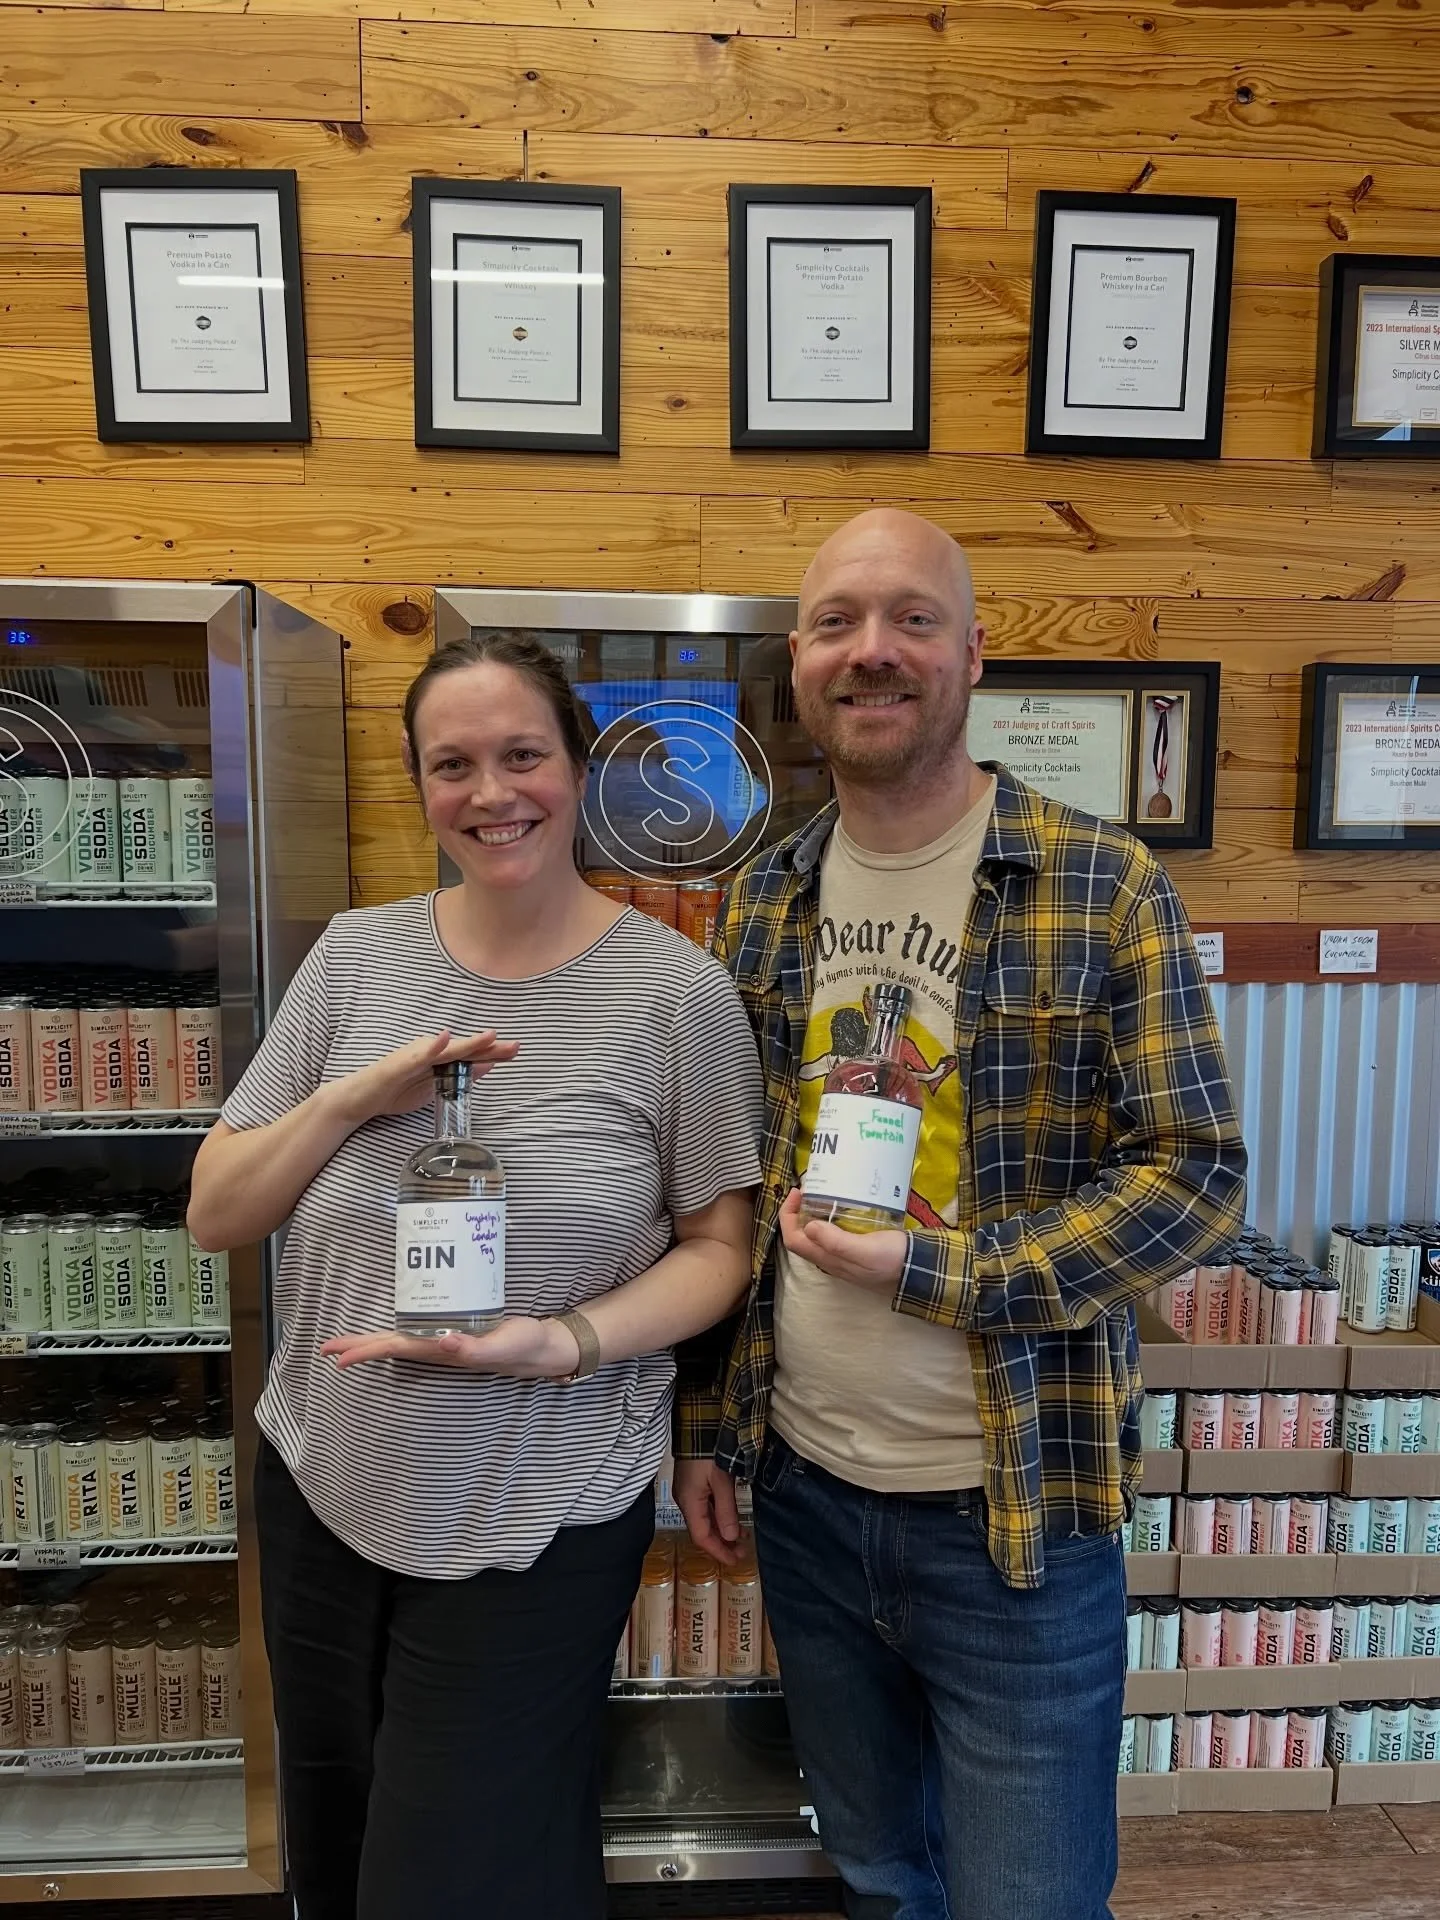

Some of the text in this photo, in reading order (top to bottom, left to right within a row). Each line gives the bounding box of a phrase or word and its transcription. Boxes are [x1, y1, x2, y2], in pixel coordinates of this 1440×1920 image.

[167, 250, 232, 259] Premium Potato
[171, 260, 196, 268] Vodka
[213, 261, 230, 269] Can
[482, 261, 559, 272] Simplicity Cocktails
[795, 263, 870, 273] Simplicity Cocktails
[801, 273, 836, 281] Premium
[1100, 272, 1168, 282] Premium Bourbon
[504, 282, 537, 291] Whiskey
[820, 282, 845, 290] Vodka
[1101, 282, 1134, 291] Whiskey
[1366, 323, 1384, 332] 2023
[1385, 324, 1431, 333] International
[1399, 339, 1431, 351] SILVER
[1392, 368, 1432, 381] Simplicity
[993, 720, 1096, 731] 2021 Judging of Craft Spirits
[1008, 735, 1080, 746] BRONZE MEDAL
[1345, 724, 1433, 734] 2023 International Spirits
[1375, 738, 1412, 749] BRONZE
[1003, 763, 1081, 774] Simplicity Cocktails
[1370, 767, 1410, 778] Simplicity
[92, 807, 107, 859] SODA
[107, 807, 115, 859] CUCUMBER
[122, 807, 134, 874] VODKA
[132, 807, 148, 859] SODA
[147, 807, 156, 860] CUCUMBER
[184, 807, 201, 874] VODKA
[200, 807, 214, 859] SODA
[1324, 935, 1348, 945] VODKA
[825, 967, 853, 984] hymns
[855, 963, 878, 976] with
[880, 966, 897, 979] the
[899, 970, 921, 989] devil
[920, 978, 929, 994] in
[42, 1039, 58, 1103] VODKA
[57, 1037, 73, 1088] SODA
[92, 1039, 109, 1104] VODKA
[108, 1038, 122, 1089] SODA
[137, 1037, 151, 1088] SODA
[183, 1037, 197, 1100] VODKA
[197, 1036, 211, 1087] SODA
[857, 1121, 904, 1144] Fountain
[872, 1108, 904, 1129] Funnel
[472, 1228, 498, 1241] London
[480, 1243, 495, 1264] Fog
[82, 1255, 95, 1305] SODA
[408, 1246, 455, 1269] GIN
[3, 1260, 13, 1309] SODA
[65, 1258, 82, 1321] VODKA
[102, 1260, 117, 1320] VODKA
[117, 1257, 131, 1307] SODA
[143, 1258, 154, 1317] VODKA
[153, 1258, 167, 1307] SODA
[190, 1257, 200, 1316] VODKA
[200, 1257, 214, 1305] SODA
[1379, 1267, 1389, 1315] VODKA
[1388, 1267, 1400, 1304] SODA
[1399, 1268, 1407, 1305] CUCUMBER
[1185, 1288, 1194, 1328] SODA
[1207, 1290, 1221, 1339] VODKA
[1220, 1289, 1229, 1329] SODA
[65, 1456, 96, 1464] SIMPLICITY
[161, 1451, 191, 1461] SIMPLICITY
[203, 1452, 232, 1460] SIMPLICITY
[1357, 1423, 1370, 1453] ODA
[14, 1475, 25, 1520] RITA
[67, 1473, 81, 1532] VODKA
[82, 1469, 98, 1517] RITA
[109, 1471, 121, 1529] VODKA
[121, 1469, 137, 1516] RITA
[163, 1468, 178, 1528] VODKA
[177, 1465, 192, 1512] RITA
[204, 1467, 218, 1525] VODKA
[218, 1465, 234, 1511] RITA
[1150, 1522, 1161, 1551] ODA
[1296, 1525, 1308, 1553] ODA
[1336, 1523, 1347, 1553] ODA
[1385, 1524, 1398, 1553] ODA
[681, 1607, 691, 1654] MARG
[692, 1610, 704, 1654] ARITA
[728, 1607, 739, 1654] MARG
[740, 1609, 751, 1652] ARITA
[1425, 1627, 1437, 1656] ODA
[20, 1680, 33, 1740] MOSCOW
[31, 1682, 46, 1727] MULE
[70, 1674, 81, 1721] MULE
[116, 1673, 126, 1732] MOSCOW
[125, 1674, 139, 1719] MULE
[159, 1674, 169, 1734] MOSCOW
[168, 1675, 182, 1721] MULE
[209, 1674, 222, 1719] MULE
[1391, 1732, 1402, 1761] ODA
[1424, 1731, 1436, 1760] ODA
